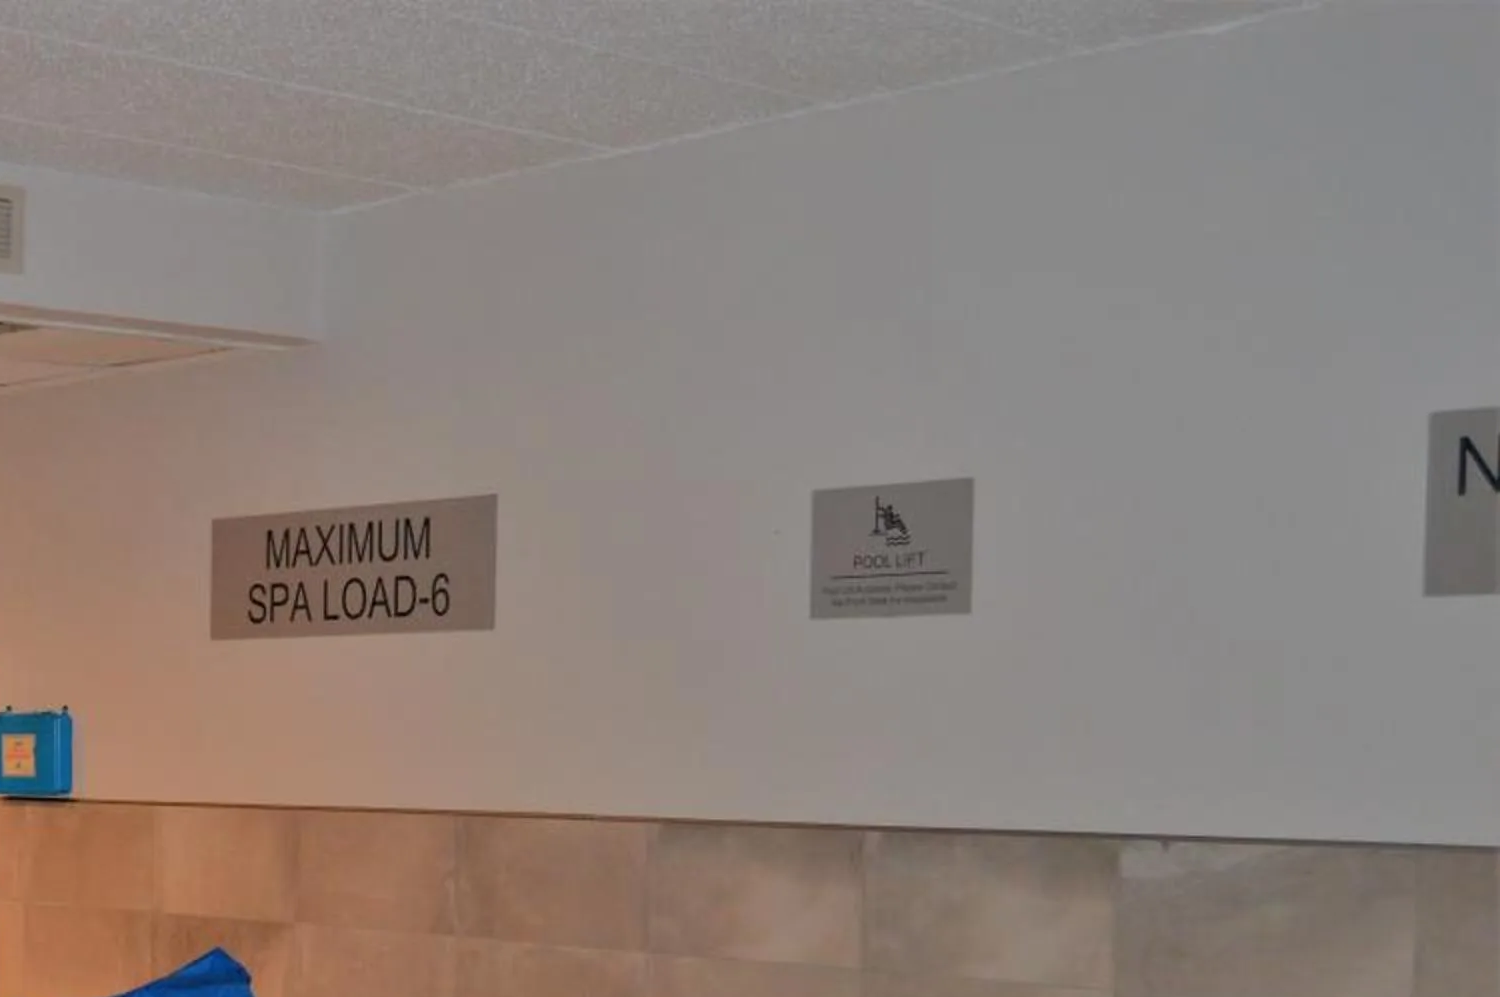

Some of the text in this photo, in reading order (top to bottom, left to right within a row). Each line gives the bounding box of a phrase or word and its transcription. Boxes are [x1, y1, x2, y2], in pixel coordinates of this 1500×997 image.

[265, 517, 431, 571] MAXIMUM
[853, 551, 925, 570] POOL LIFT
[247, 573, 451, 625] SPA LOAD-6
